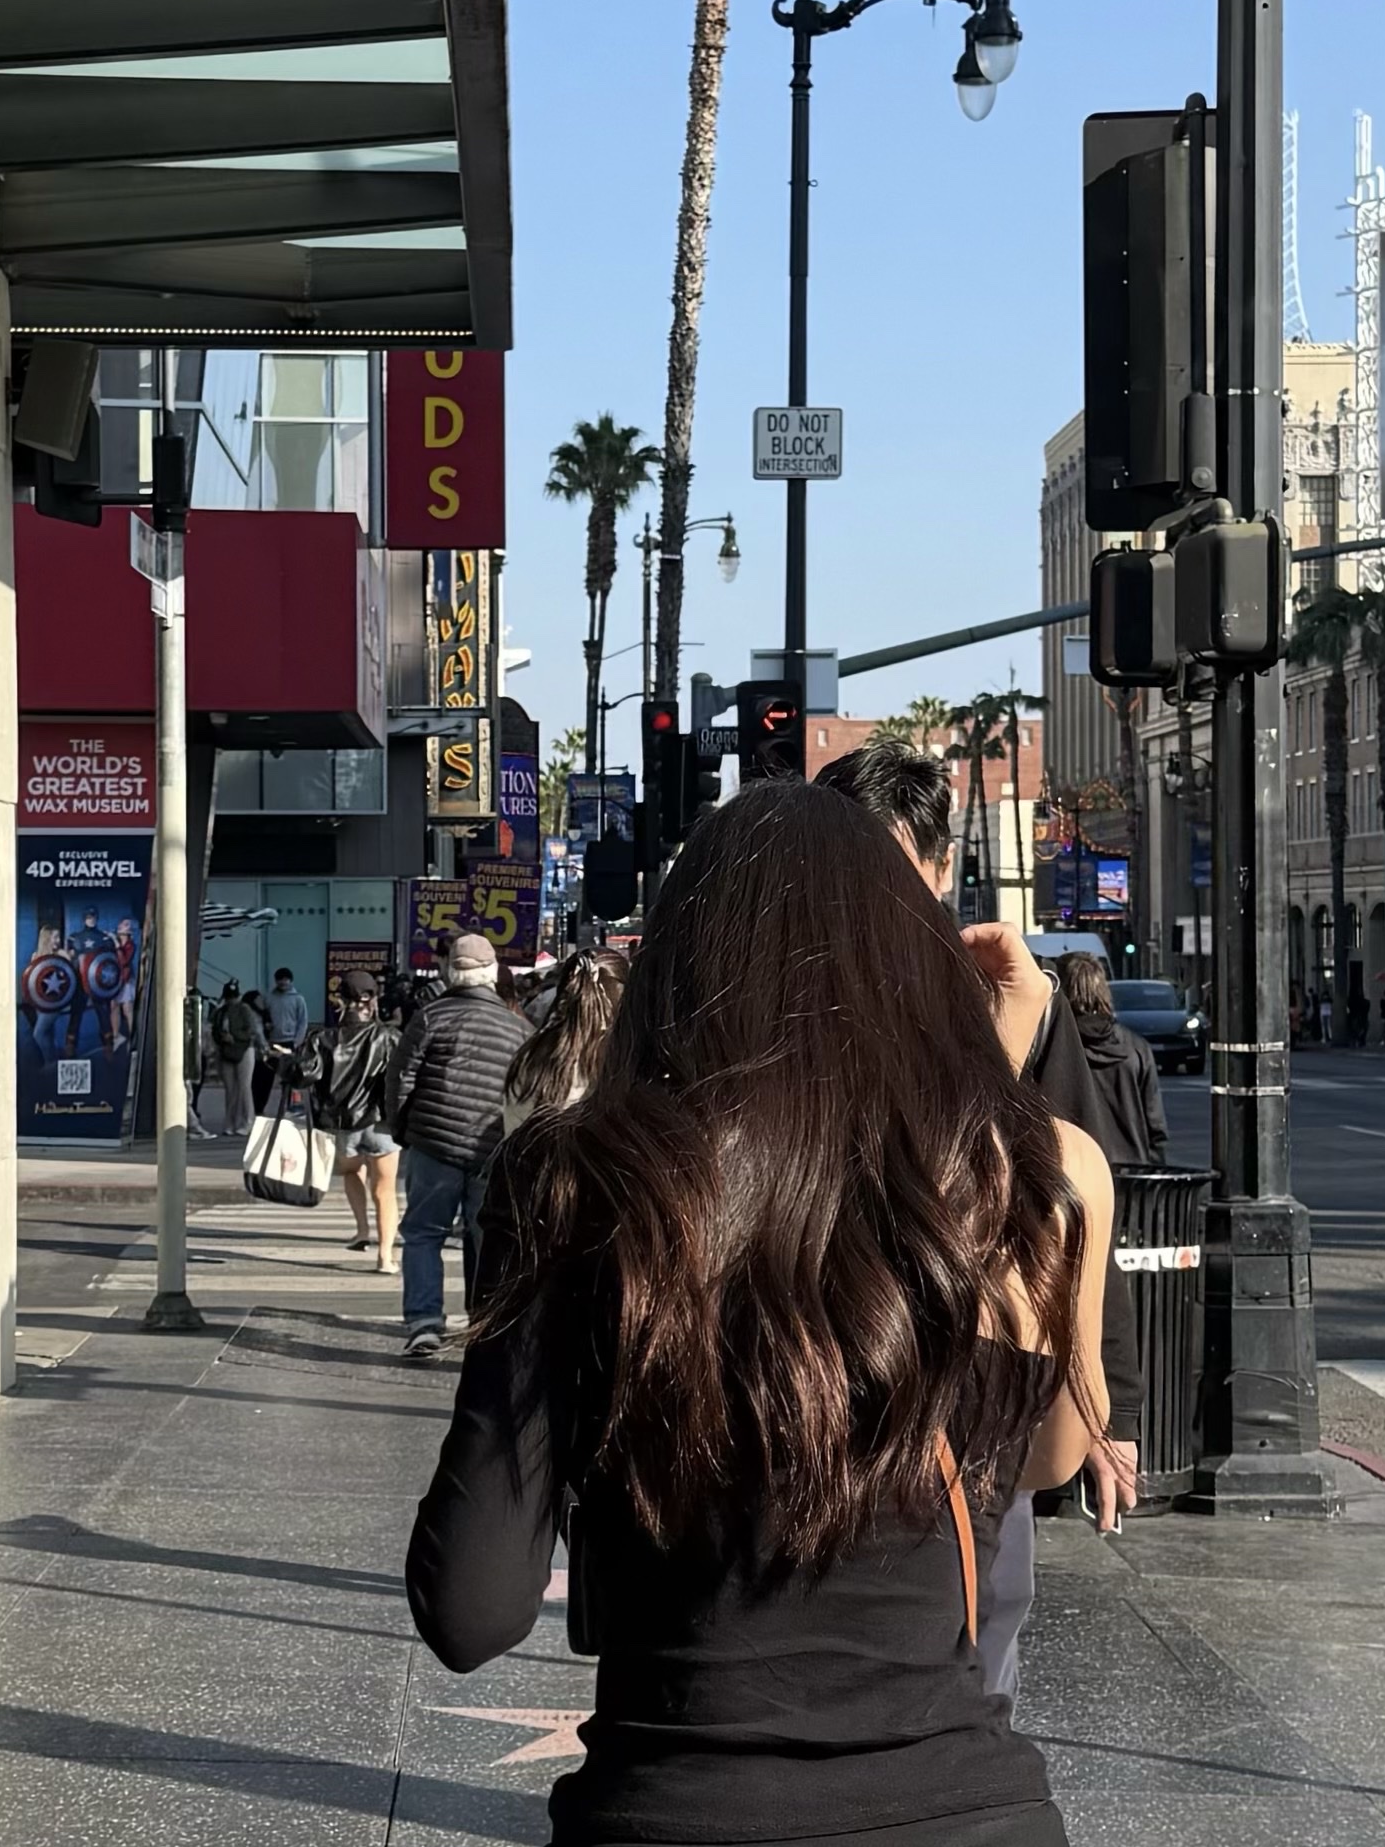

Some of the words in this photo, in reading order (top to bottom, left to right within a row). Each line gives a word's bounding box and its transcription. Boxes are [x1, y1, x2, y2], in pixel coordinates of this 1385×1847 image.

[767, 413, 789, 433] DO
[799, 413, 830, 433] NOT
[771, 436, 825, 455] BLOCK
[758, 456, 837, 472] INTERSECTION
[700, 728, 739, 747] Orang
[69, 739, 105, 753] THE
[32, 756, 142, 775] WORLD'S
[27, 777, 147, 795] GREATEST
[25, 798, 68, 813] WAX
[73, 798, 149, 813] MUSEUM
[26, 861, 54, 877] 4D
[58, 861, 142, 877] MARVEL
[477, 863, 534, 877] PREMIERE
[420, 882, 467, 892] PREMIER
[469, 873, 540, 889] SOUVENIRS
[413, 891, 467, 903] SOUVENI
[472, 887, 518, 946] $5
